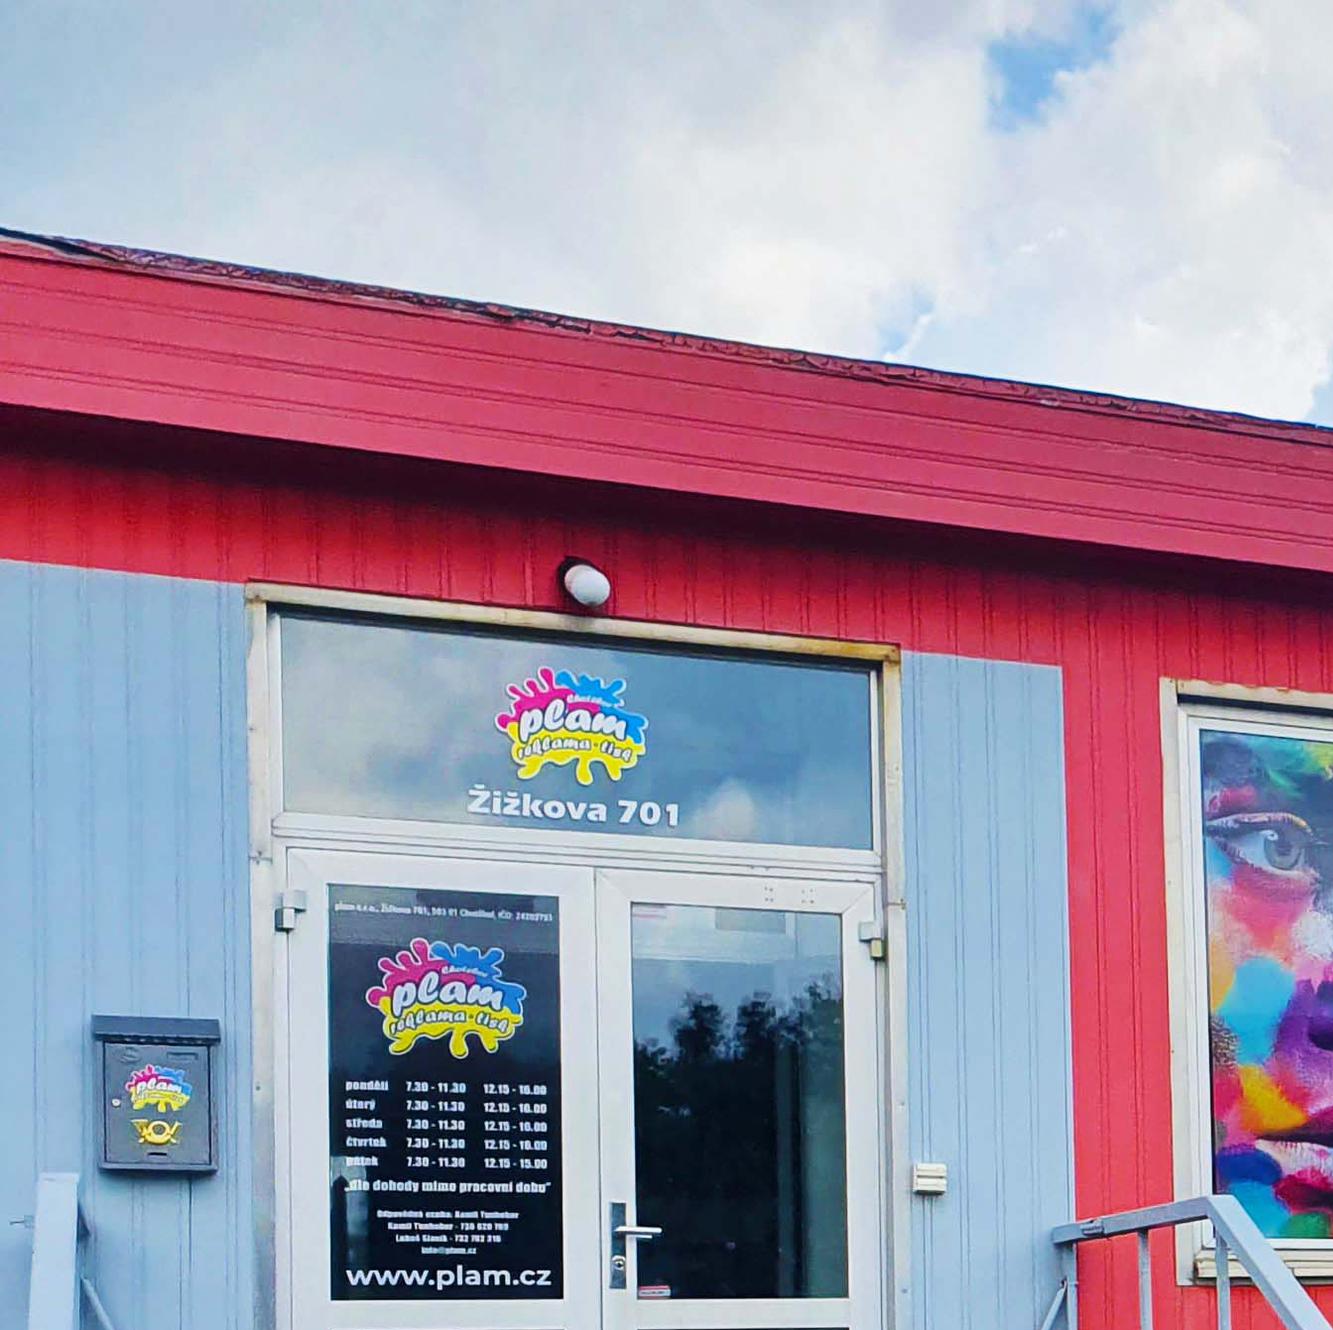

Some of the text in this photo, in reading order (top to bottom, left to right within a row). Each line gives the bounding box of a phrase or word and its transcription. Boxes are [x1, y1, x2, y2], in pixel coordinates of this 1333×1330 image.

[519, 698, 627, 741] plam
[467, 784, 680, 827] Žižkova 701
[393, 971, 503, 1016] plam
[389, 1009, 466, 1035] reklama
[406, 1082, 428, 1092] 7.30
[438, 1082, 466, 1093] 11.30
[406, 1100, 428, 1110] 7.30
[438, 1101, 466, 1112] 11.30
[406, 1119, 428, 1129] 7.30
[438, 1120, 466, 1131] 11.30
[406, 1138, 428, 1148] 7.30
[438, 1138, 466, 1149] 11.30
[406, 1157, 428, 1167] 7.30
[438, 1157, 466, 1168] 11.30
[373, 1180, 419, 1193] dohody
[459, 1182, 513, 1194] pracovní
[346, 1265, 552, 1290] www.plam.cz
